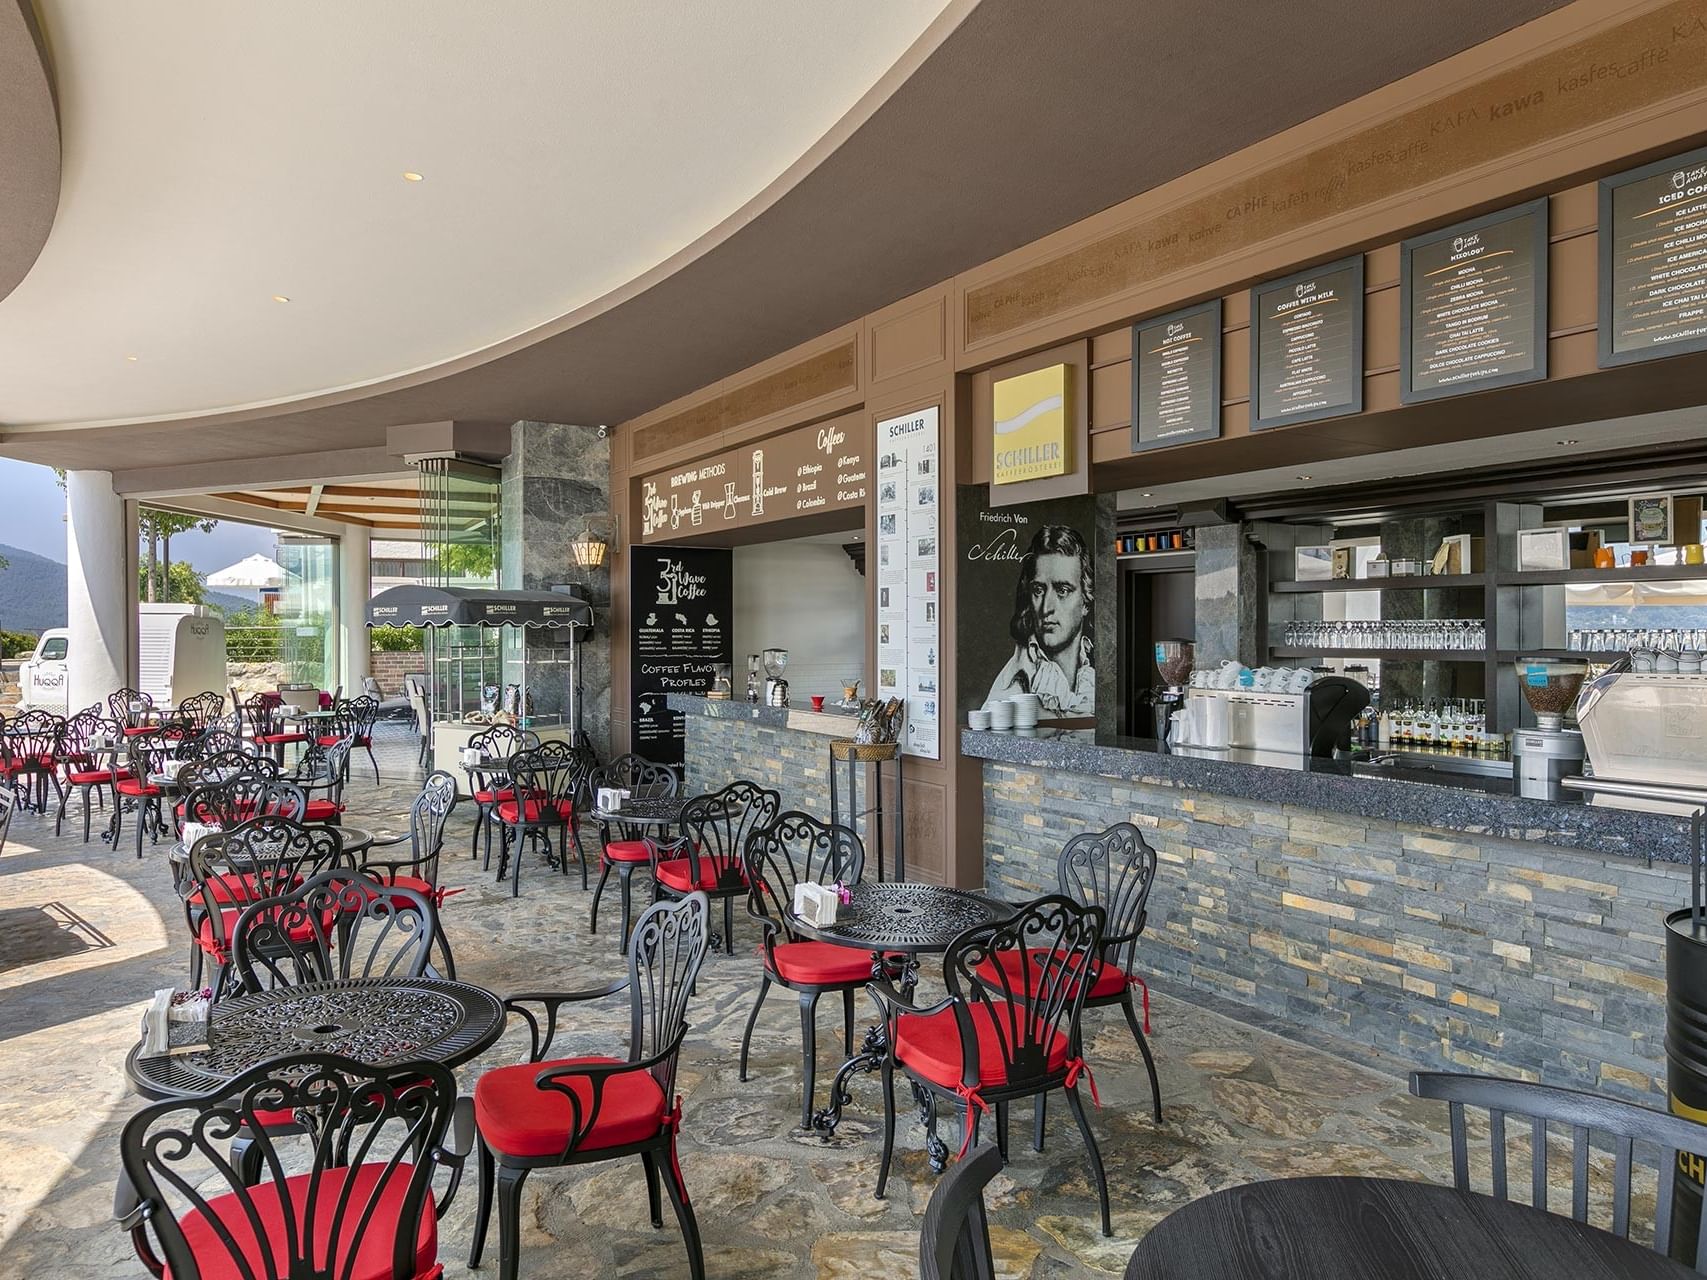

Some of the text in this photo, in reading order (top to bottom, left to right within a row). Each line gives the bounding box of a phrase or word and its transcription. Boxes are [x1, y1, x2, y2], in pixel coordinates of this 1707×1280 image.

[1488, 89, 1544, 122] kawa
[1429, 106, 1479, 136] KAFA
[1686, 166, 1706, 178] TAKE
[1658, 191, 1684, 205] ICED
[1147, 233, 1179, 253] kawa
[1463, 234, 1479, 244] TAKE
[1663, 241, 1675, 249] ICE
[1675, 236, 1695, 246] CHILLI
[1450, 246, 1485, 262] MIXOLOGY
[1667, 255, 1678, 263] ICE
[1458, 266, 1476, 276] MOCHA
[1651, 272, 1670, 281] WHITE
[1466, 278, 1483, 287] MOCHA
[1649, 288, 1667, 297] DARK
[1667, 279, 1706, 293] CHOCOLATE
[1277, 290, 1334, 312] COFFEE WITH MILK
[1450, 290, 1484, 303] ZEBRA MOCHA
[1674, 296, 1690, 305] CHAI
[1436, 310, 1451, 319] WHITE
[1451, 303, 1479, 315] CHOCOLATE
[1480, 299, 1498, 308] MOCHA
[1679, 309, 1704, 319] FRAPPE
[1174, 332, 1192, 342] COFFEE
[1469, 327, 1484, 335] LATTE
[1435, 347, 1449, 355] DARK
[1449, 342, 1477, 353] CHOCOLATE
[1429, 360, 1446, 369] DOLCE
[1446, 354, 1473, 366] CHOCOLATE
[1474, 349, 1506, 360] CAPPUCCINO
[889, 418, 924, 438] SCHILLER
[816, 427, 845, 454] Coffees
[843, 455, 860, 466] Kenya
[996, 441, 1060, 470] SCHILLER
[670, 463, 726, 488] BREWING METHODS
[802, 464, 822, 475] Ethiopia
[802, 480, 816, 492] Brazil
[763, 488, 775, 497] Cold
[843, 490, 859, 500] Costa
[802, 496, 826, 508] Colombia
[979, 512, 1028, 524] Friedrich Von
[968, 528, 1034, 562] Schiller
[679, 571, 707, 586] Wave
[678, 584, 707, 600] Coffee
[379, 606, 398, 615] SCHILLER
[427, 605, 448, 614] SCHILLER
[493, 605, 516, 613] SCHILLER
[551, 606, 570, 615] SCHILLER
[641, 663, 681, 674] COFFEE
[660, 677, 706, 687] PROFILES
